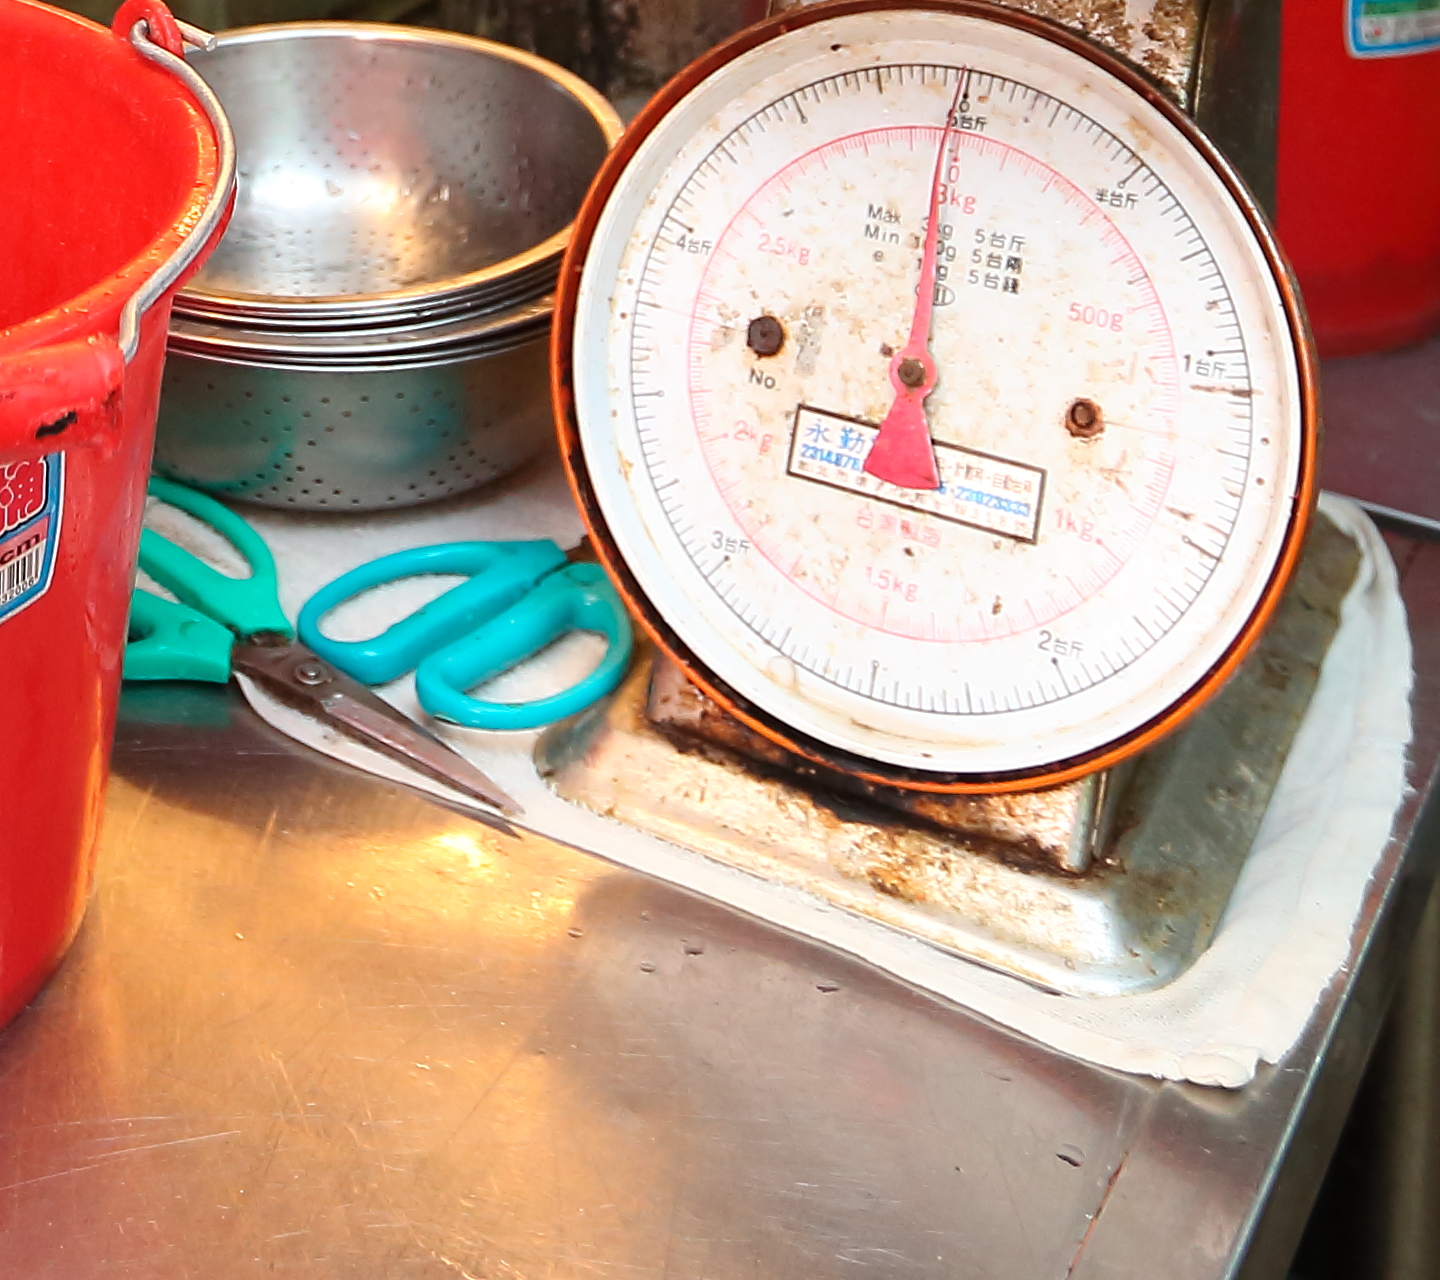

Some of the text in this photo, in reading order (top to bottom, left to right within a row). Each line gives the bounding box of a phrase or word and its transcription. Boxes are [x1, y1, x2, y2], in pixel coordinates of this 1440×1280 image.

[864, 224, 900, 244] Min
[867, 203, 902, 224] Max
[974, 227, 1025, 252] 5台斤
[676, 235, 713, 254] 4台斤
[1069, 301, 1124, 333] 500g
[1183, 354, 1227, 379] 1台斤
[733, 420, 773, 454] 2kg
[1054, 508, 1096, 542] 1kg
[711, 530, 751, 555] 3台斤
[865, 565, 919, 603] 1.5kg
[1037, 630, 1084, 658] 2台斤
